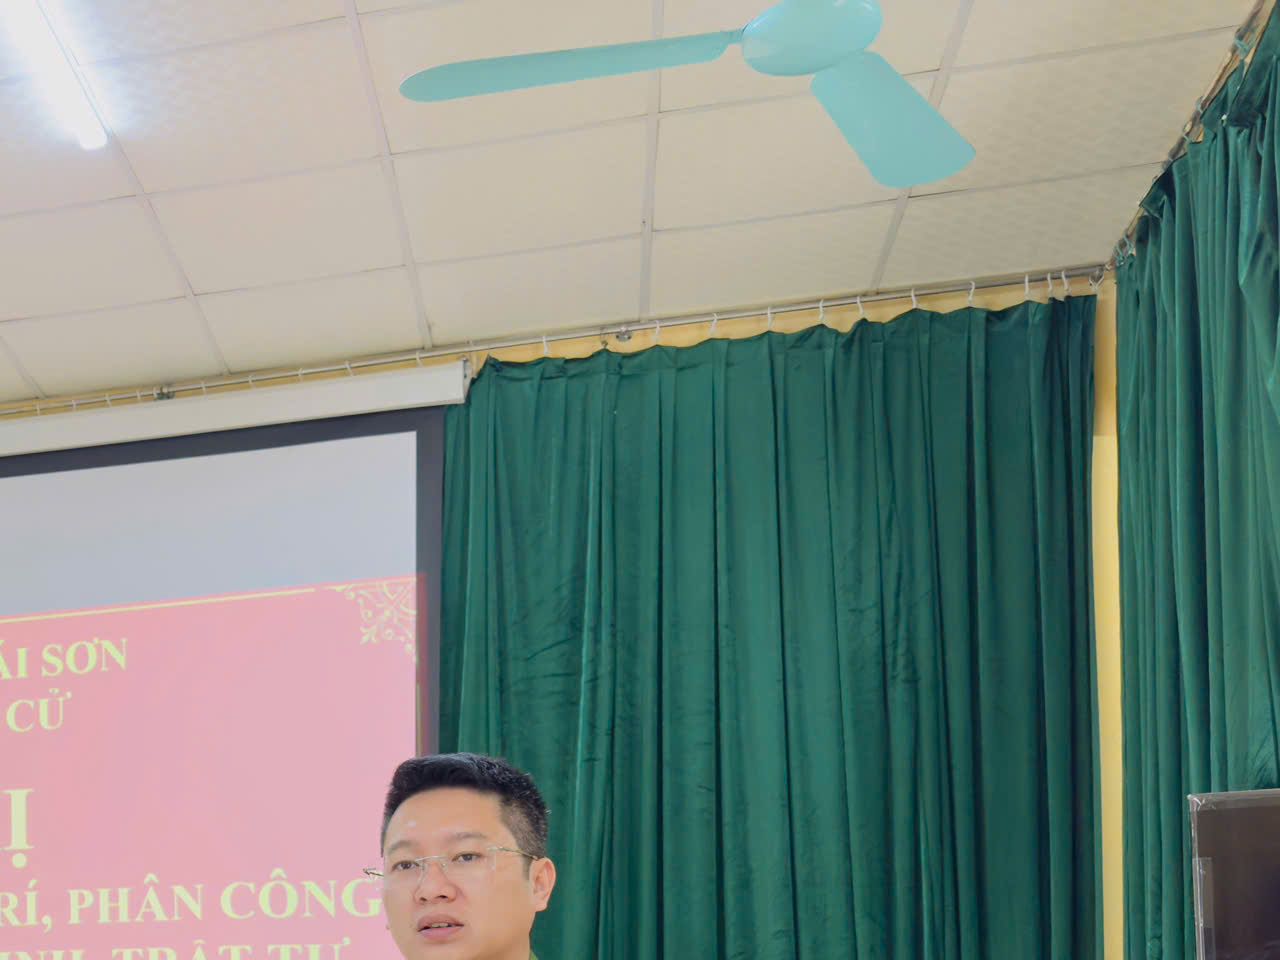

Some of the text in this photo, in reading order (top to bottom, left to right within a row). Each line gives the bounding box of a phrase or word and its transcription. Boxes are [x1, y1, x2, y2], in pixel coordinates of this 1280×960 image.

[41, 637, 127, 677] SƠN
[7, 687, 73, 733] CỬ
[68, 873, 204, 925] PHÂN
[220, 867, 384, 919] CÔNG
